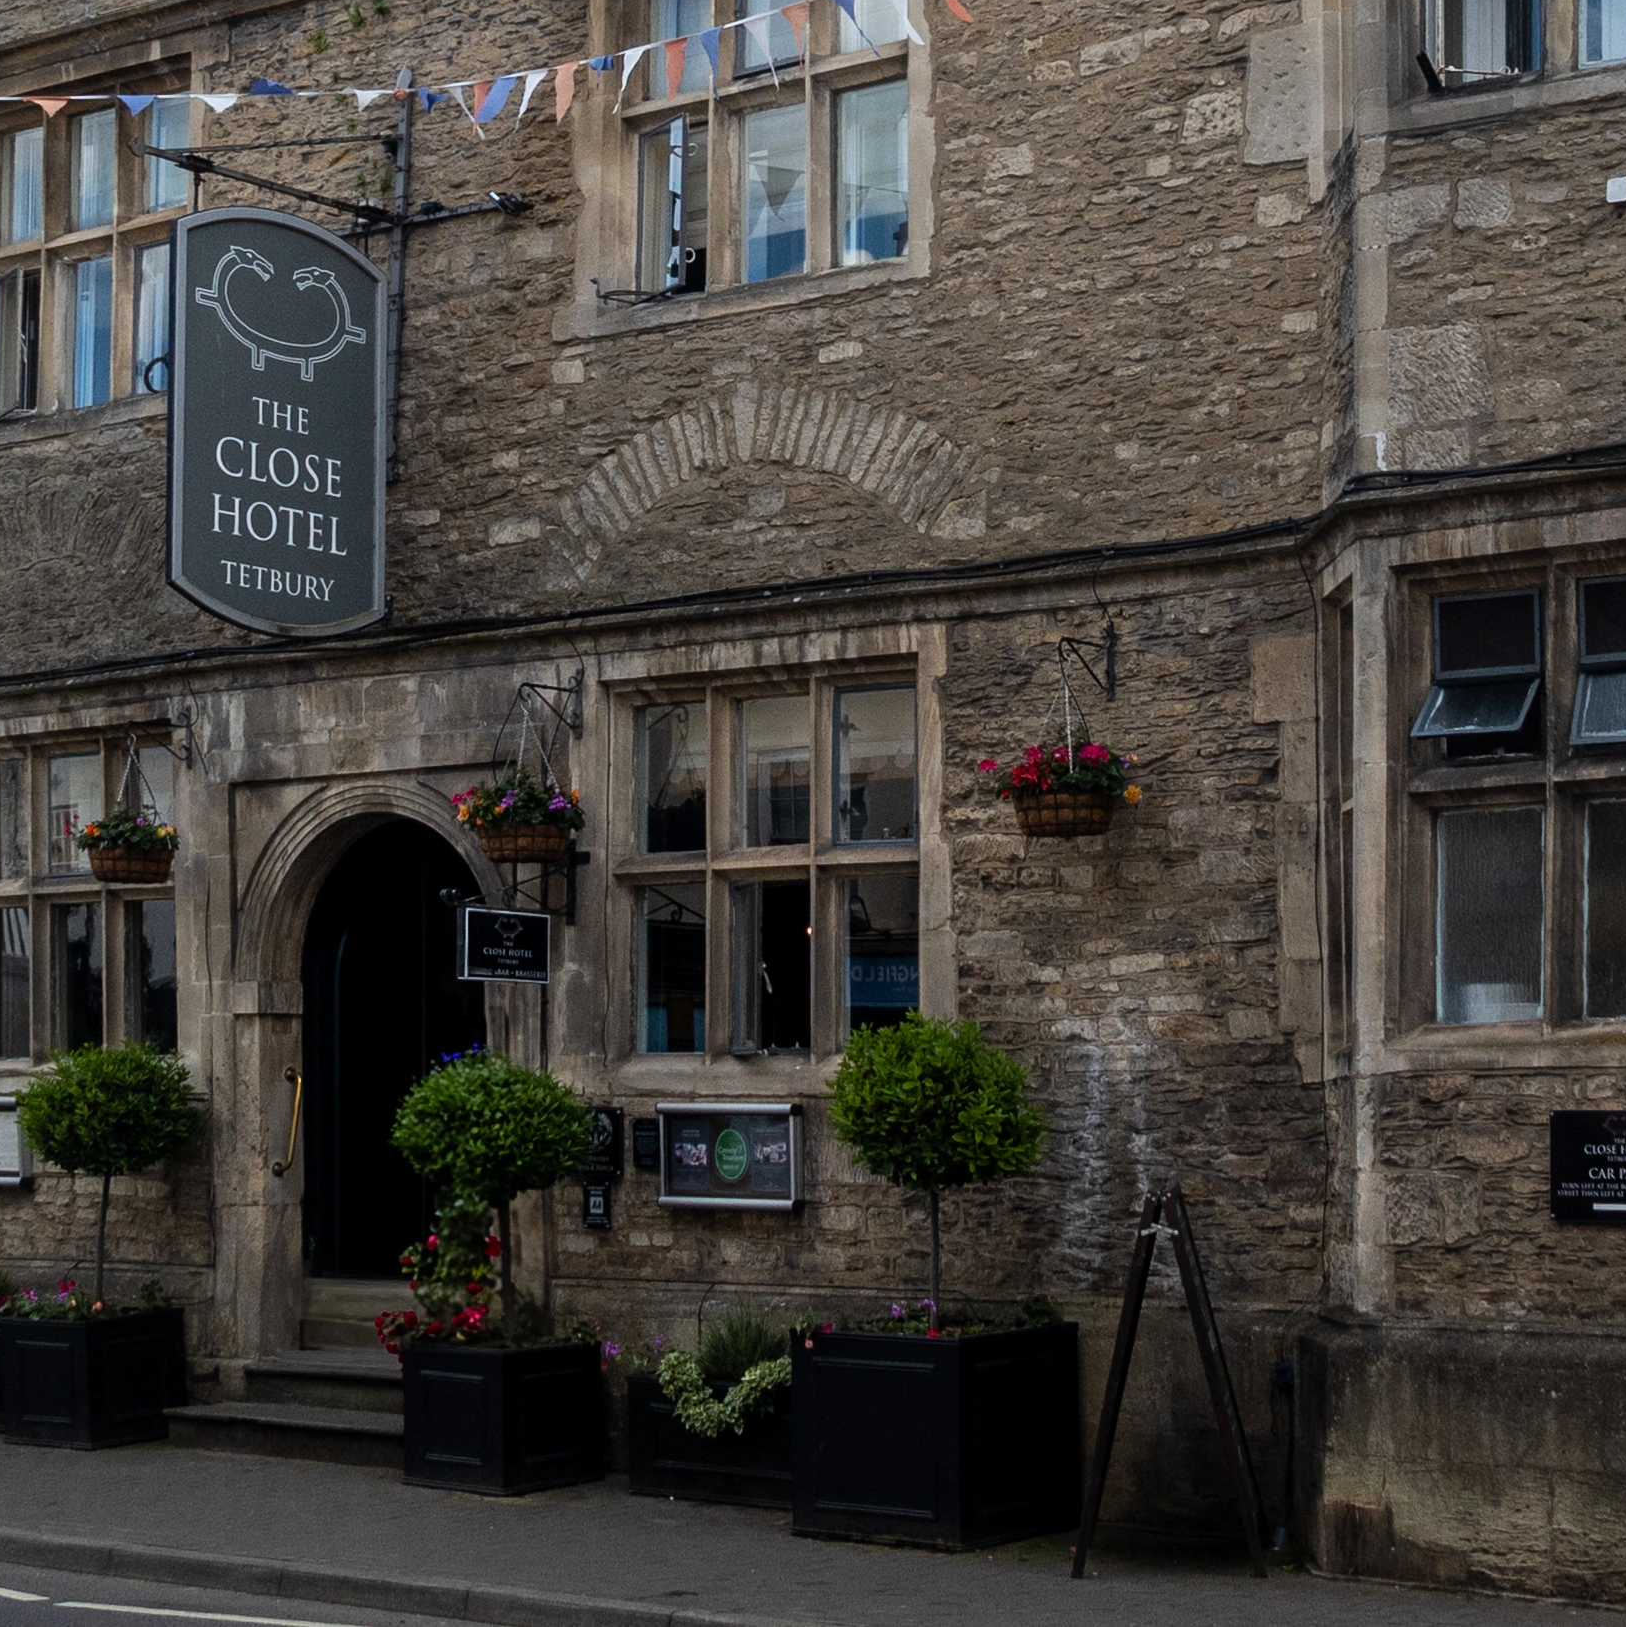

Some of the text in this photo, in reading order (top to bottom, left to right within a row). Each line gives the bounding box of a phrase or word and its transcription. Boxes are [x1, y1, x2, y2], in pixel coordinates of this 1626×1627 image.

[252, 396, 309, 435] THE
[216, 436, 342, 498] CLOSE
[211, 492, 348, 556] HOTEL
[220, 560, 335, 601] TETBURY
[483, 947, 533, 958] CLOSE HOTEL
[1584, 1144, 1617, 1155] CLOSE
[1588, 1167, 1616, 1179] CAR
